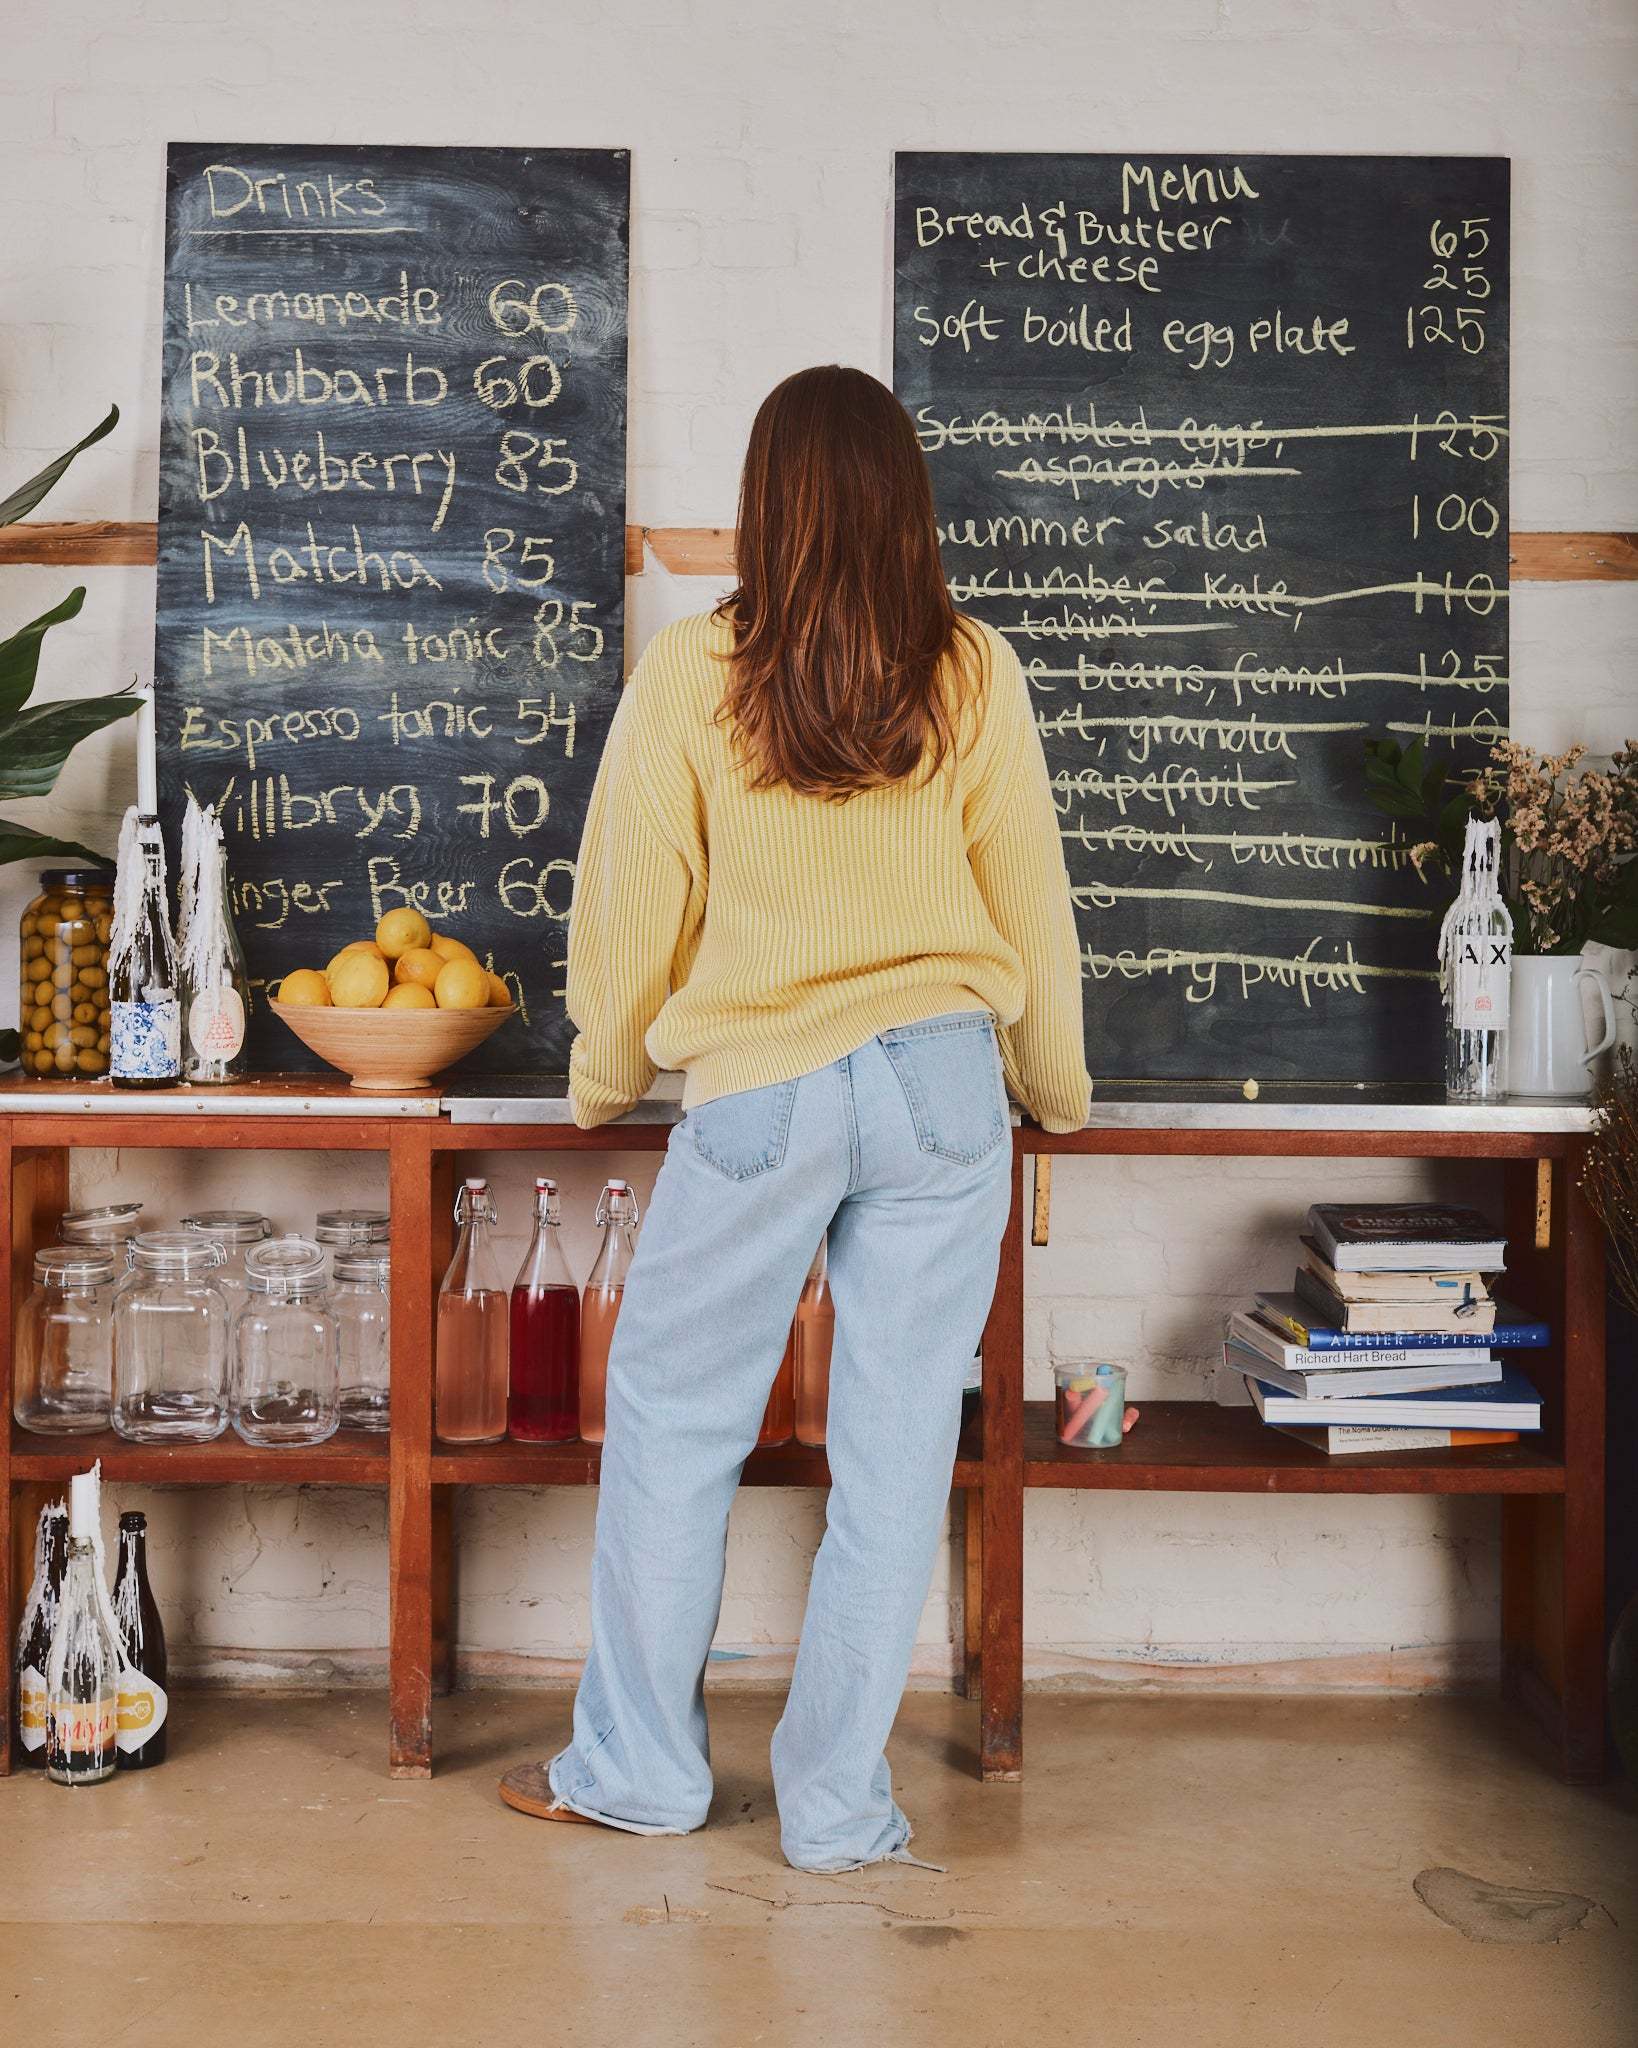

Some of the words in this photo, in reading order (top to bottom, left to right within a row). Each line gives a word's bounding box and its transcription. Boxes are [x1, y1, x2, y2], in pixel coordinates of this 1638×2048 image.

[203, 165, 386, 218] Drinks
[1123, 161, 1259, 213] Menu
[916, 203, 1034, 247] Bread
[1077, 211, 1232, 251] Butter
[1430, 218, 1490, 259] 65
[184, 270, 442, 337] Lemonade
[488, 280, 577, 337] 60
[1018, 251, 1162, 292] cheese
[1423, 264, 1490, 299] 25
[914, 300, 1004, 353] Soft
[1023, 305, 1133, 352] boiled
[1163, 317, 1235, 370] egg
[1250, 309, 1356, 357] plate
[1406, 306, 1486, 354] 125
[191, 348, 449, 409] Rhubarb
[473, 355, 563, 409] 60
[1411, 411, 1500, 460] 125
[192, 427, 457, 532] Blueberry
[495, 431, 578, 494] 85
[937, 512, 1125, 549] ummer
[1142, 512, 1267, 552] salad
[1412, 494, 1499, 539] 100
[201, 522, 443, 603] Matcha
[481, 527, 555, 594] 85
[949, 562, 1166, 614] ucumber,
[202, 620, 384, 677] Matcha
[402, 617, 508, 665] tonic
[533, 600, 605, 668] 85
[1419, 650, 1503, 693] 125
[180, 707, 360, 770] Espresso
[378, 687, 492, 744] tonic
[514, 692, 577, 758] 54
[457, 772, 550, 839] 70
[178, 872, 345, 929] inger
[367, 856, 476, 922] Beer
[496, 857, 577, 921] 60
[1080, 943, 1217, 1003] berry
[1295, 1352, 1340, 1365] Richard
[1343, 1351, 1369, 1363] Hart
[1372, 1349, 1406, 1362] Bread
[1330, 1334, 1404, 1347] ATELIER
